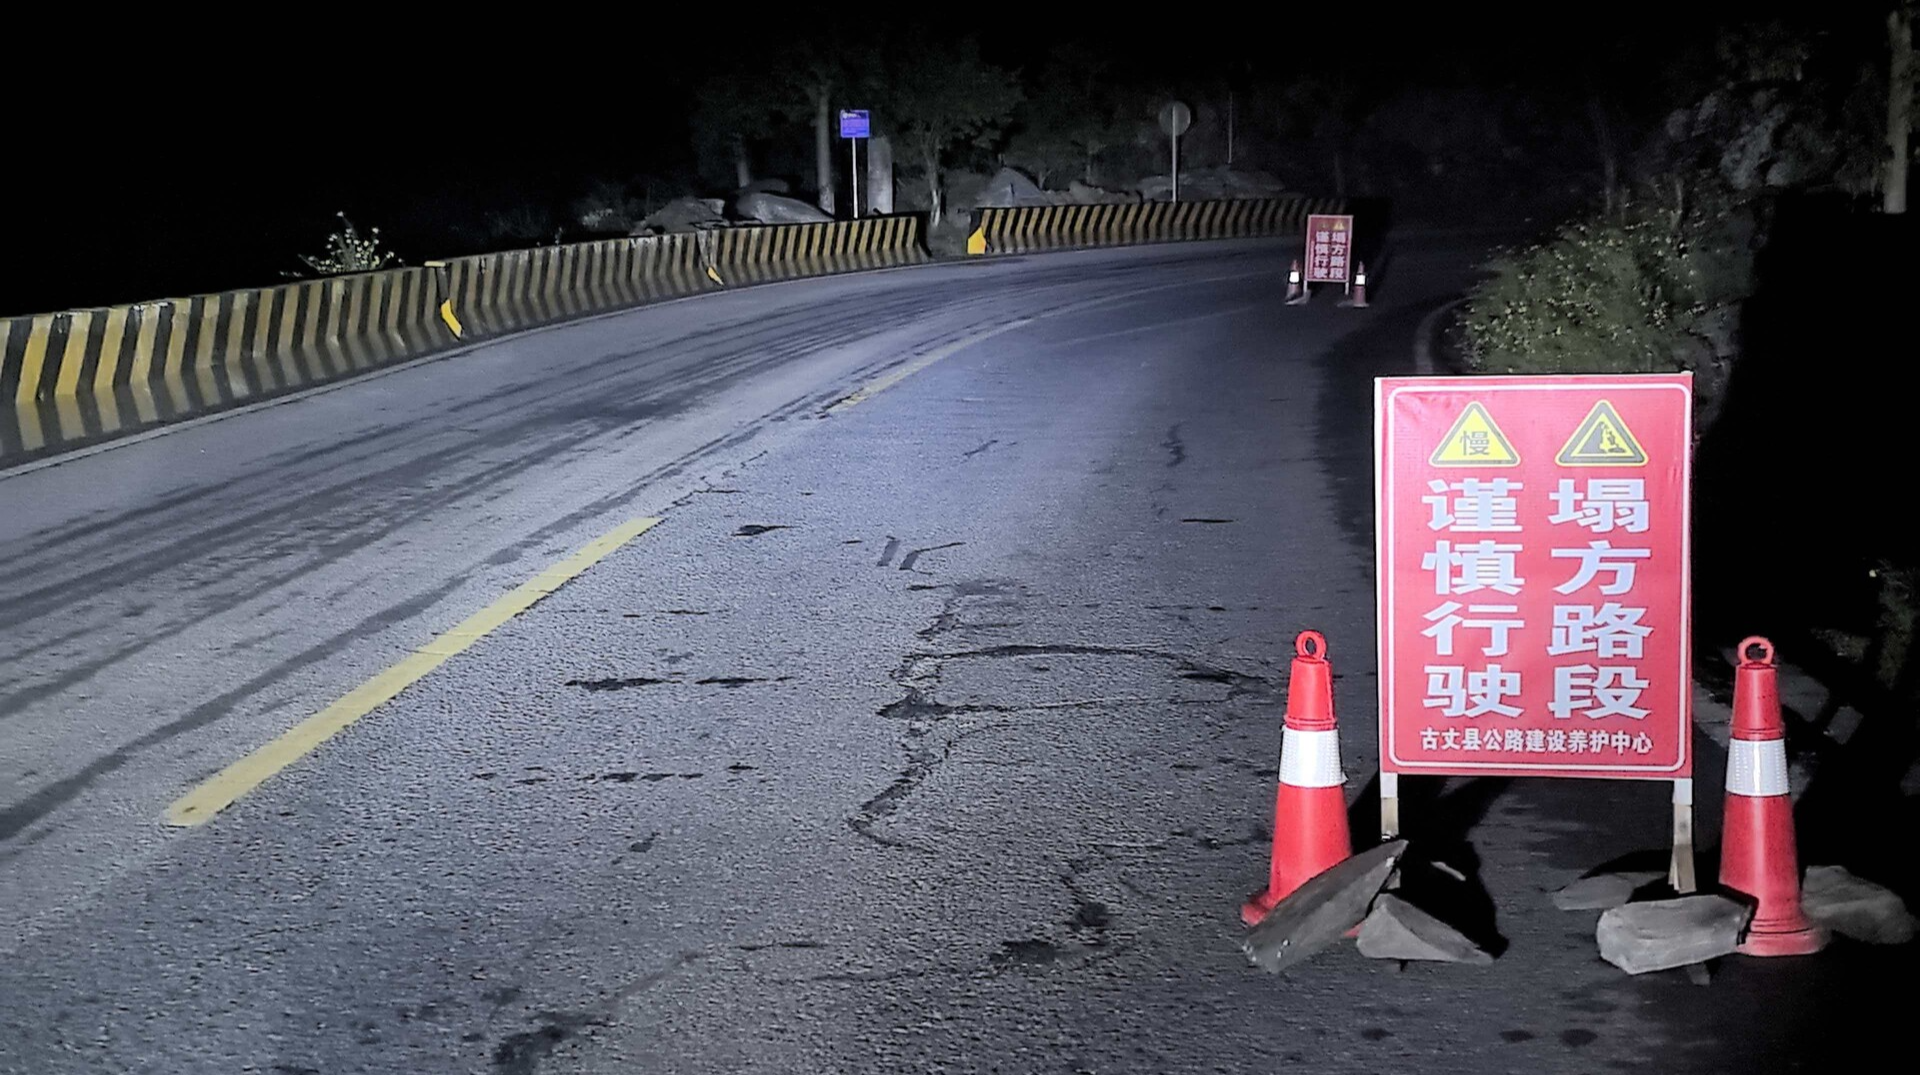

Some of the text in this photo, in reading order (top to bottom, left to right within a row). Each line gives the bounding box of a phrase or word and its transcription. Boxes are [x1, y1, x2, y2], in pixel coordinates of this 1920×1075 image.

[1459, 429, 1490, 457] 慢
[1421, 477, 1525, 719] 谨慎行驶
[1547, 477, 1653, 720] 塌方路段
[1420, 726, 1653, 755] 古丈县公路建设养护中心
